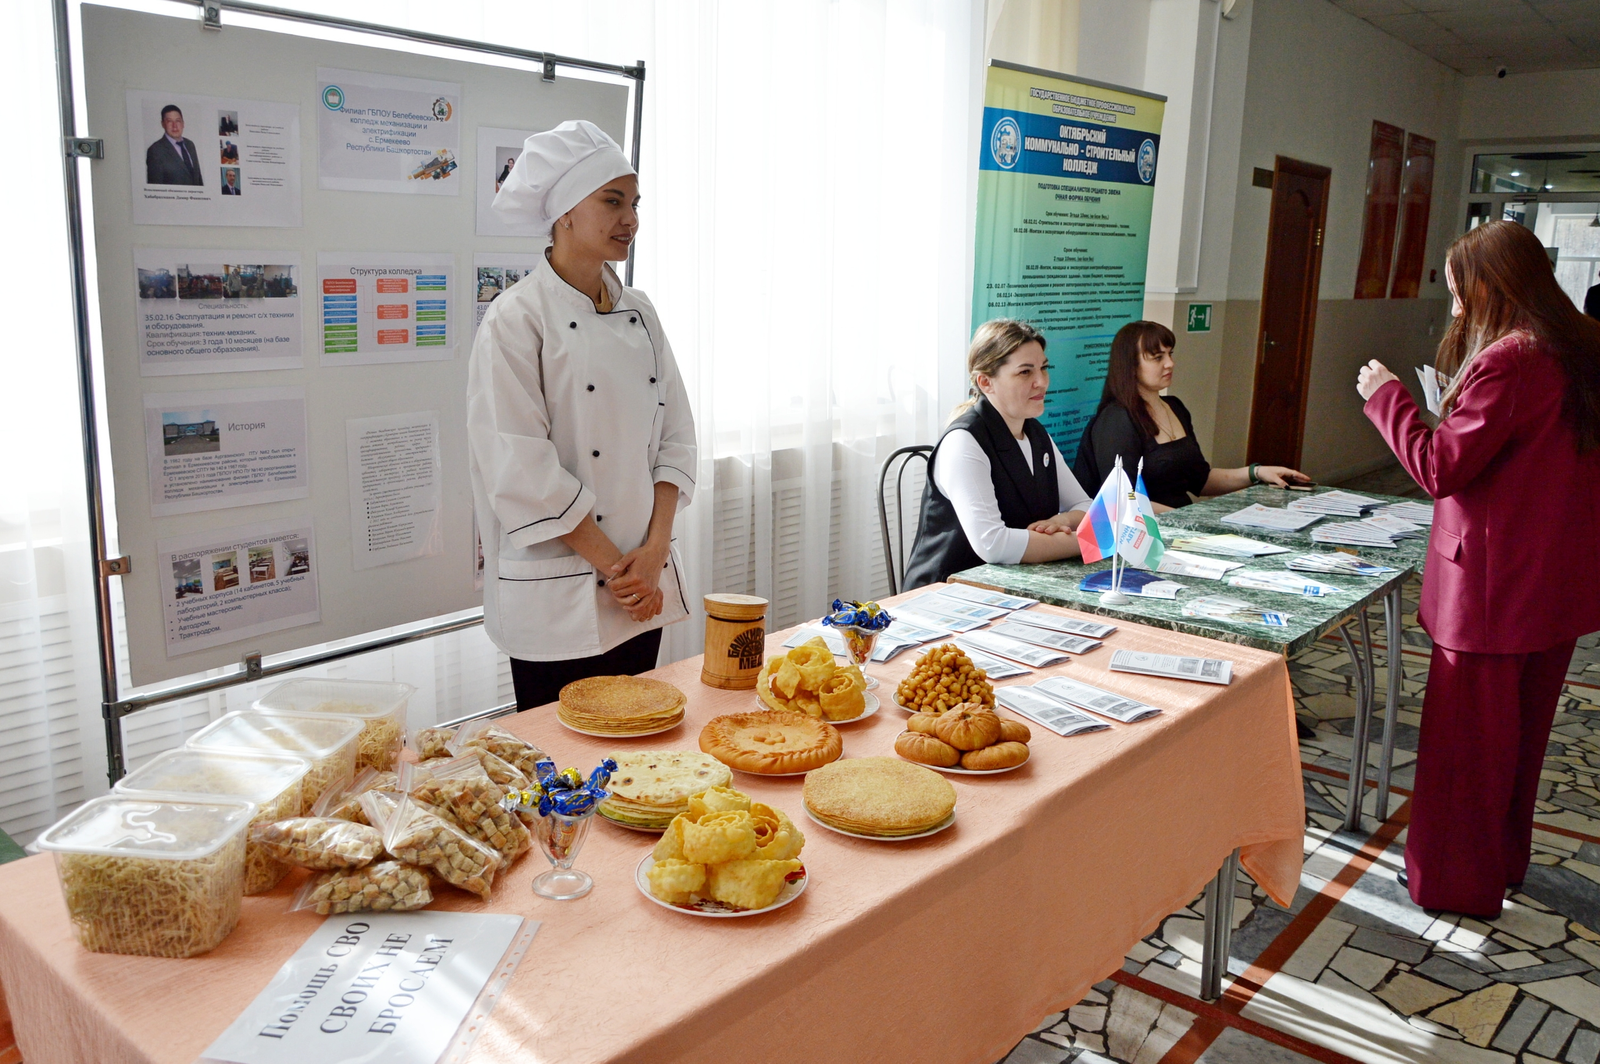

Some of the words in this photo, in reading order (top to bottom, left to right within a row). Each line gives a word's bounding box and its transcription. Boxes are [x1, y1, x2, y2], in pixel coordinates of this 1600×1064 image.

[340, 106, 366, 116] Филиал
[367, 108, 391, 118] ГБПОУ
[350, 117, 379, 126] колледж
[380, 120, 422, 130] механизации
[362, 127, 417, 138] электрификации
[1059, 125, 1106, 144] ОКТЯБРЬСКИЙ
[374, 136, 411, 146] Ермекеево
[346, 143, 386, 153] Республики
[386, 146, 432, 156] Башкортостан
[1024, 136, 1079, 156] КОММУНАЛЬНО
[1086, 144, 1136, 164] СТРОИТЕЛЬНЫЙ
[1062, 159, 1098, 175] КОЛЛЕДЖ
[350, 267, 387, 276] Структура
[388, 268, 422, 276] колледжа
[175, 313, 225, 321] Эксплуатация
[152, 322, 205, 330] оборудования.
[146, 340, 165, 348] Срок
[166, 339, 202, 347] обучения:
[275, 335, 290, 343] базе
[147, 348, 184, 356] основного
[186, 347, 212, 355] общего
[228, 422, 266, 431] История
[178, 546, 232, 561] распоряжении
[233, 538, 268, 550] студентов
[269, 533, 300, 544] имеется:
[181, 596, 208, 606] учебных
[209, 590, 234, 601] корпуса
[234, 587, 244, 596] (14
[244, 582, 275, 593] кабинетов,
[280, 575, 306, 586] учебных
[177, 601, 219, 615] лабораторий,
[224, 591, 268, 605] компьютерных
[178, 612, 206, 623] Учебные
[206, 604, 244, 617] мастерские;
[257, 962, 339, 1040] Помощь
[325, 921, 371, 958] СВО
[319, 961, 390, 1034] СВОИХ
[376, 932, 413, 960] НЕ
[366, 937, 454, 1035] БРОСАЕМ
